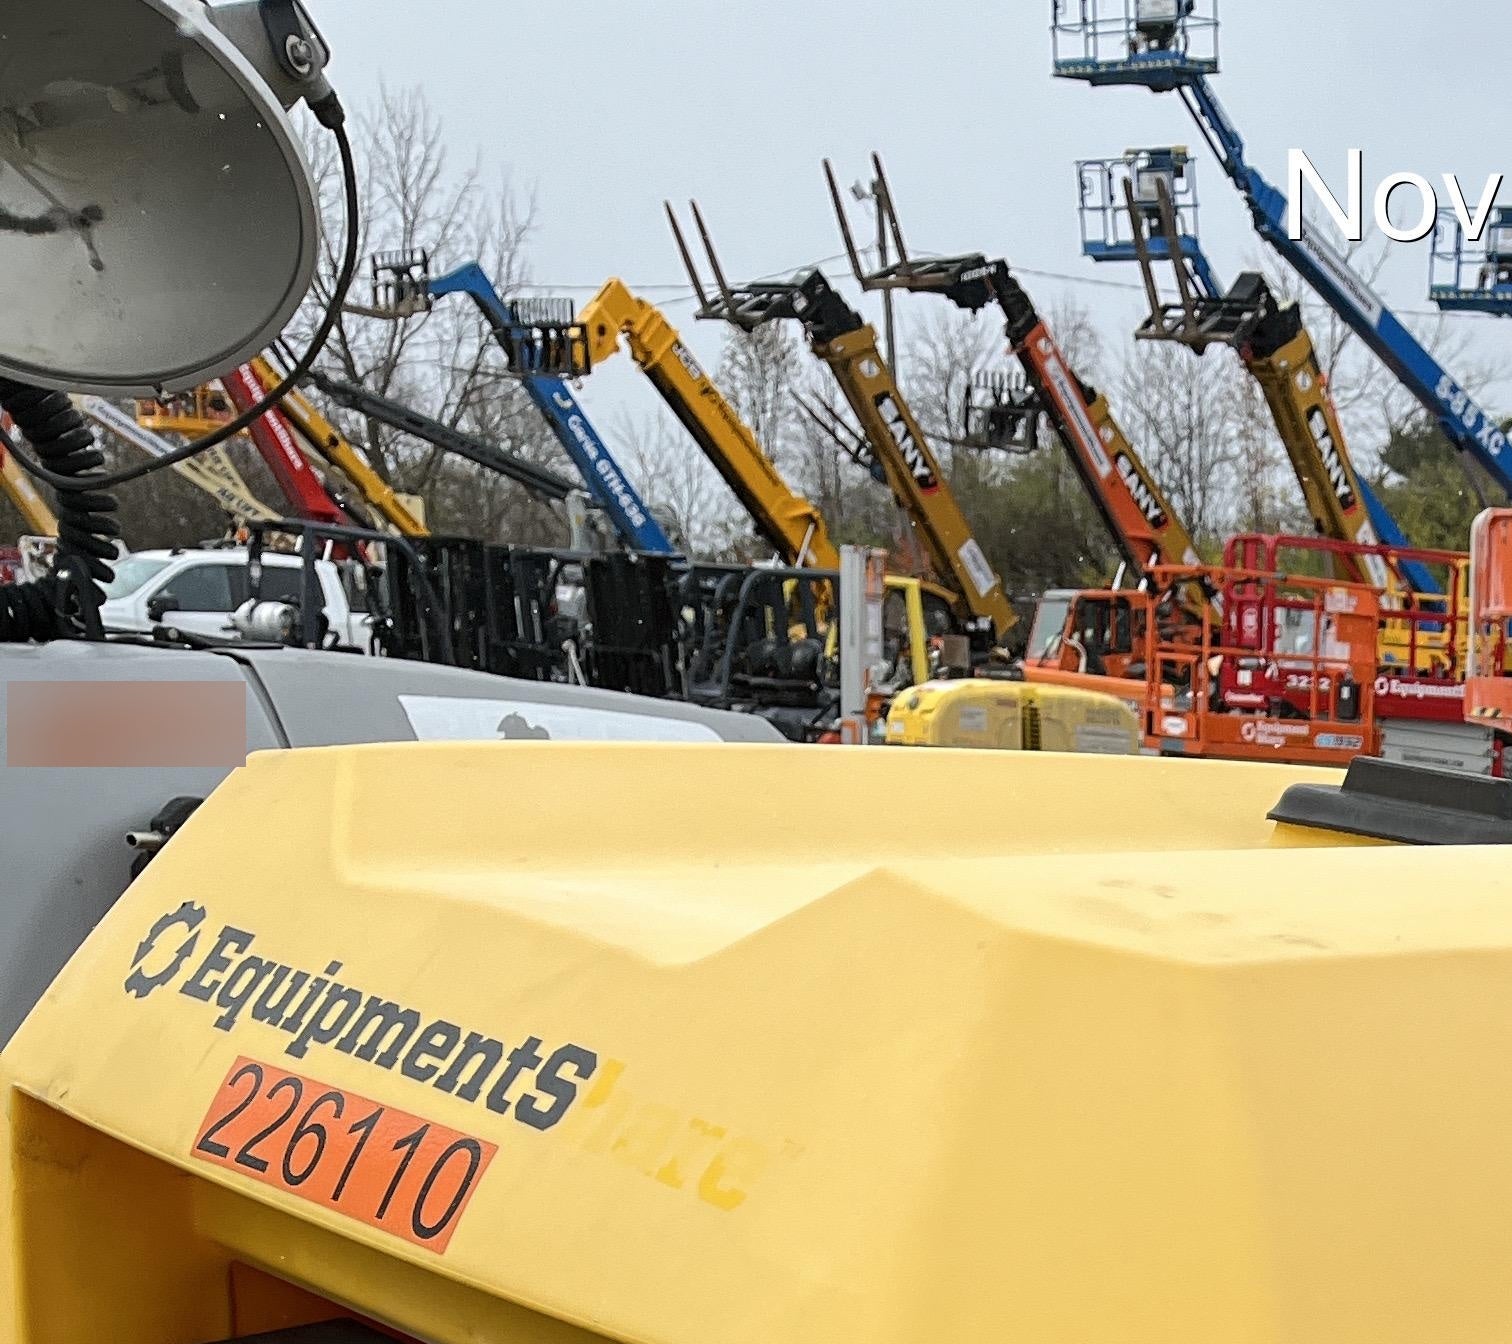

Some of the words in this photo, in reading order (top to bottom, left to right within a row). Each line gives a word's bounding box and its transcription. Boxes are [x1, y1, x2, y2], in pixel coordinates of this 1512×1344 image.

[876, 396, 932, 479] SANY
[1308, 409, 1352, 496] SANY
[1116, 453, 1164, 521] SANY
[1286, 673, 1331, 691] 322
[196, 1063, 483, 1240] 226110
